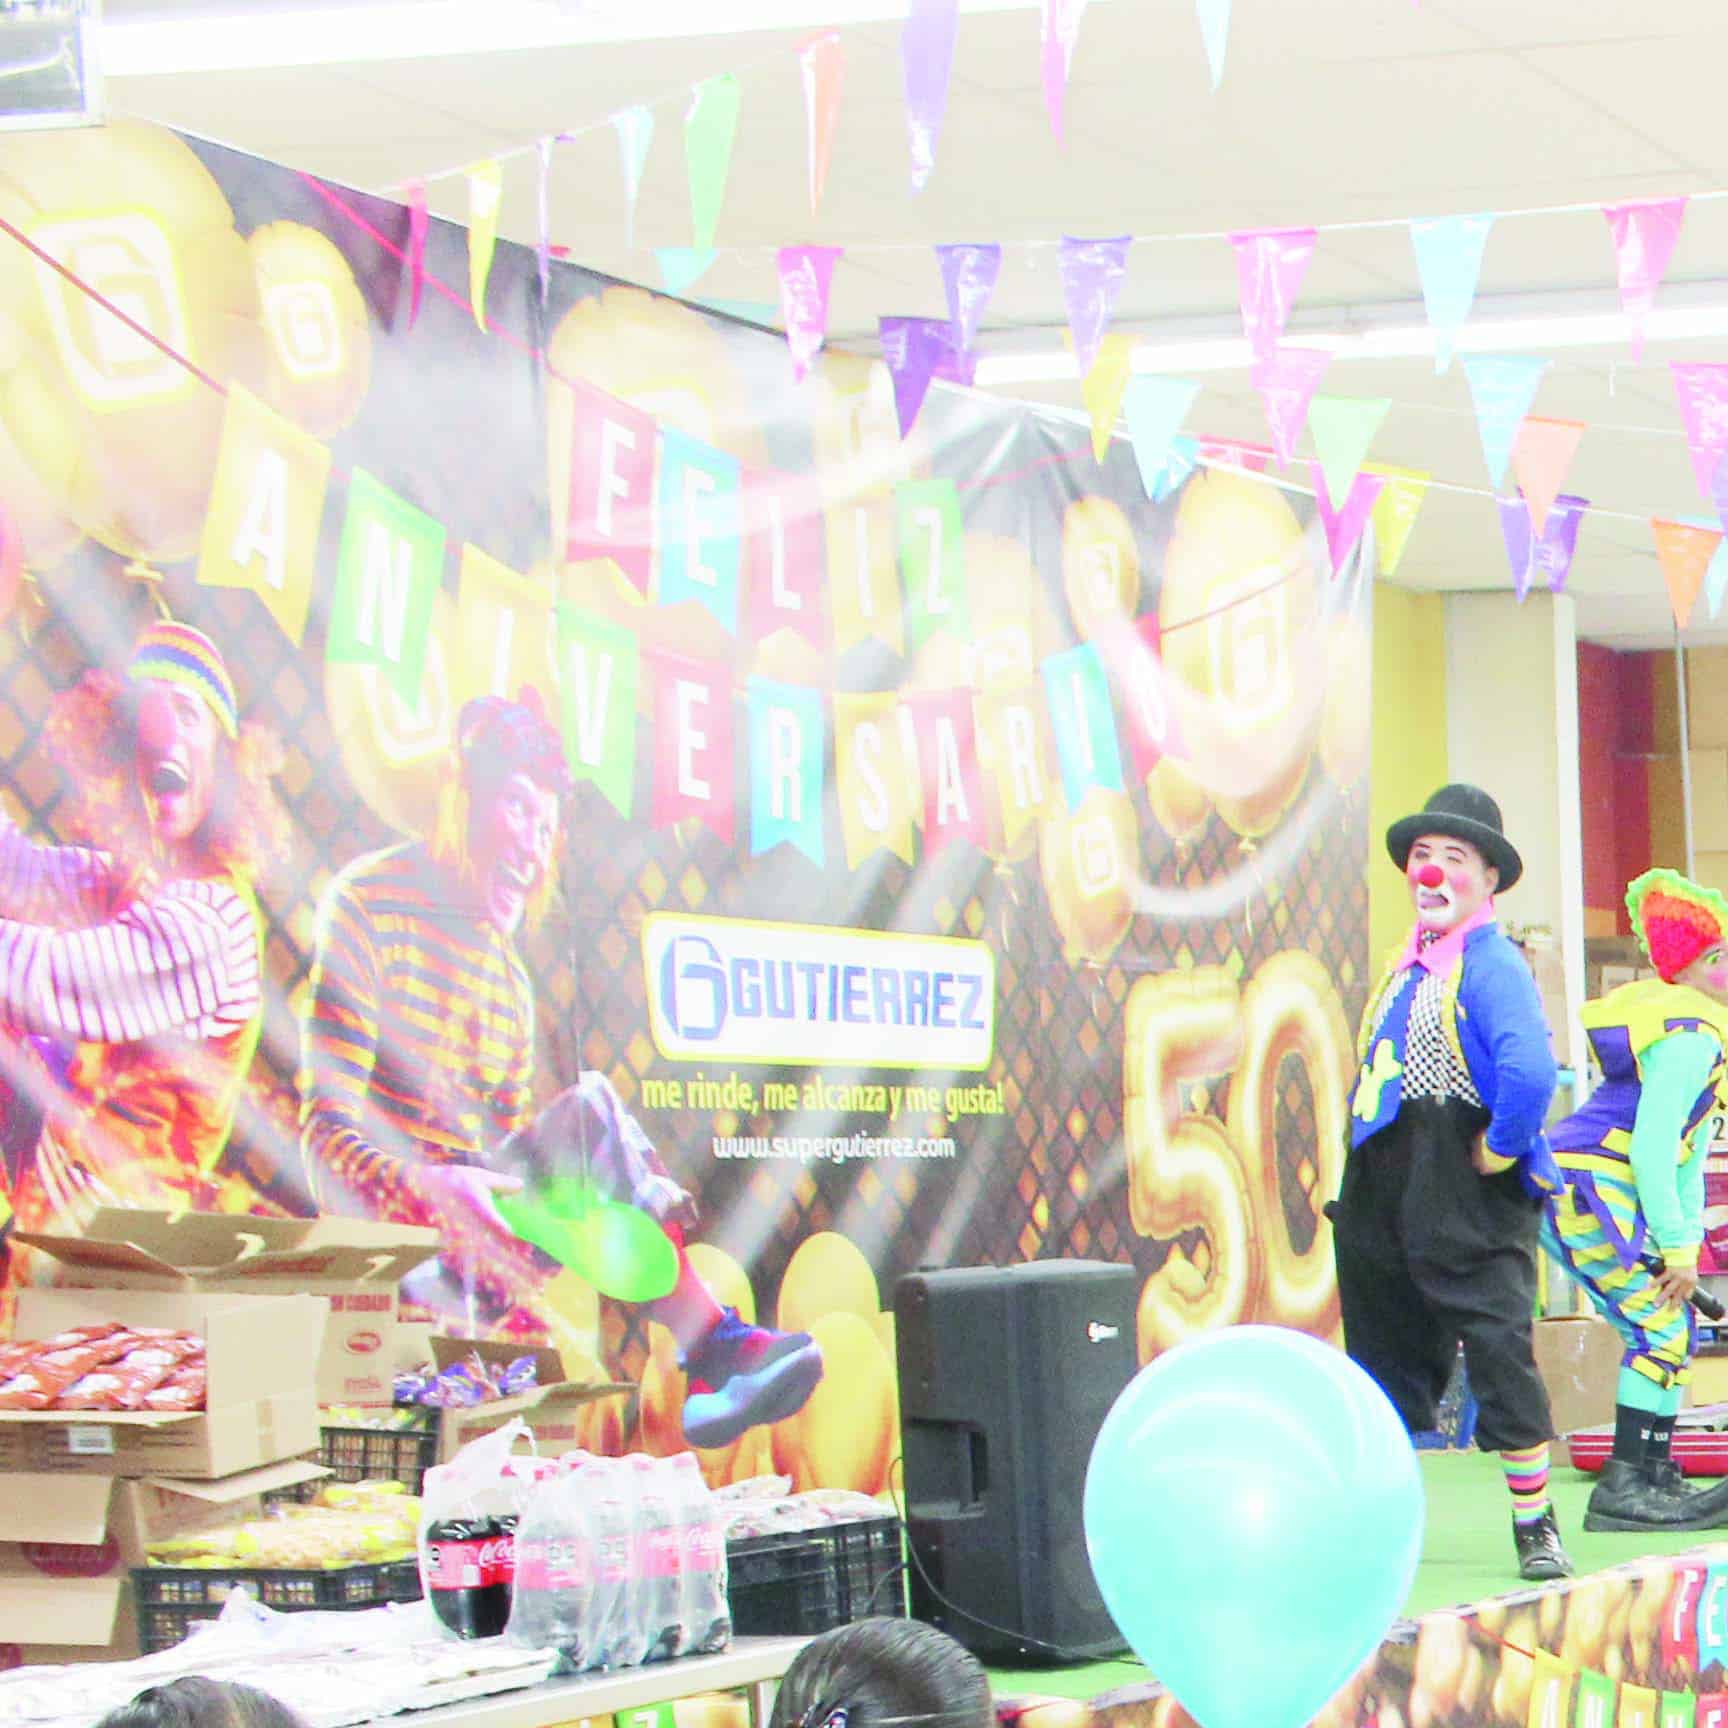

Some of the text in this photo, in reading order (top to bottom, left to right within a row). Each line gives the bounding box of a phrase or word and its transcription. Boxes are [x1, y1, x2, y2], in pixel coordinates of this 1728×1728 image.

[598, 414, 954, 618] FELIZ
[729, 956, 986, 1031] GUTIERREZ
[641, 1071, 1005, 1121] me rinde, me alcanza y me gusta!
[712, 1130, 956, 1163] www.supergutierrez.com
